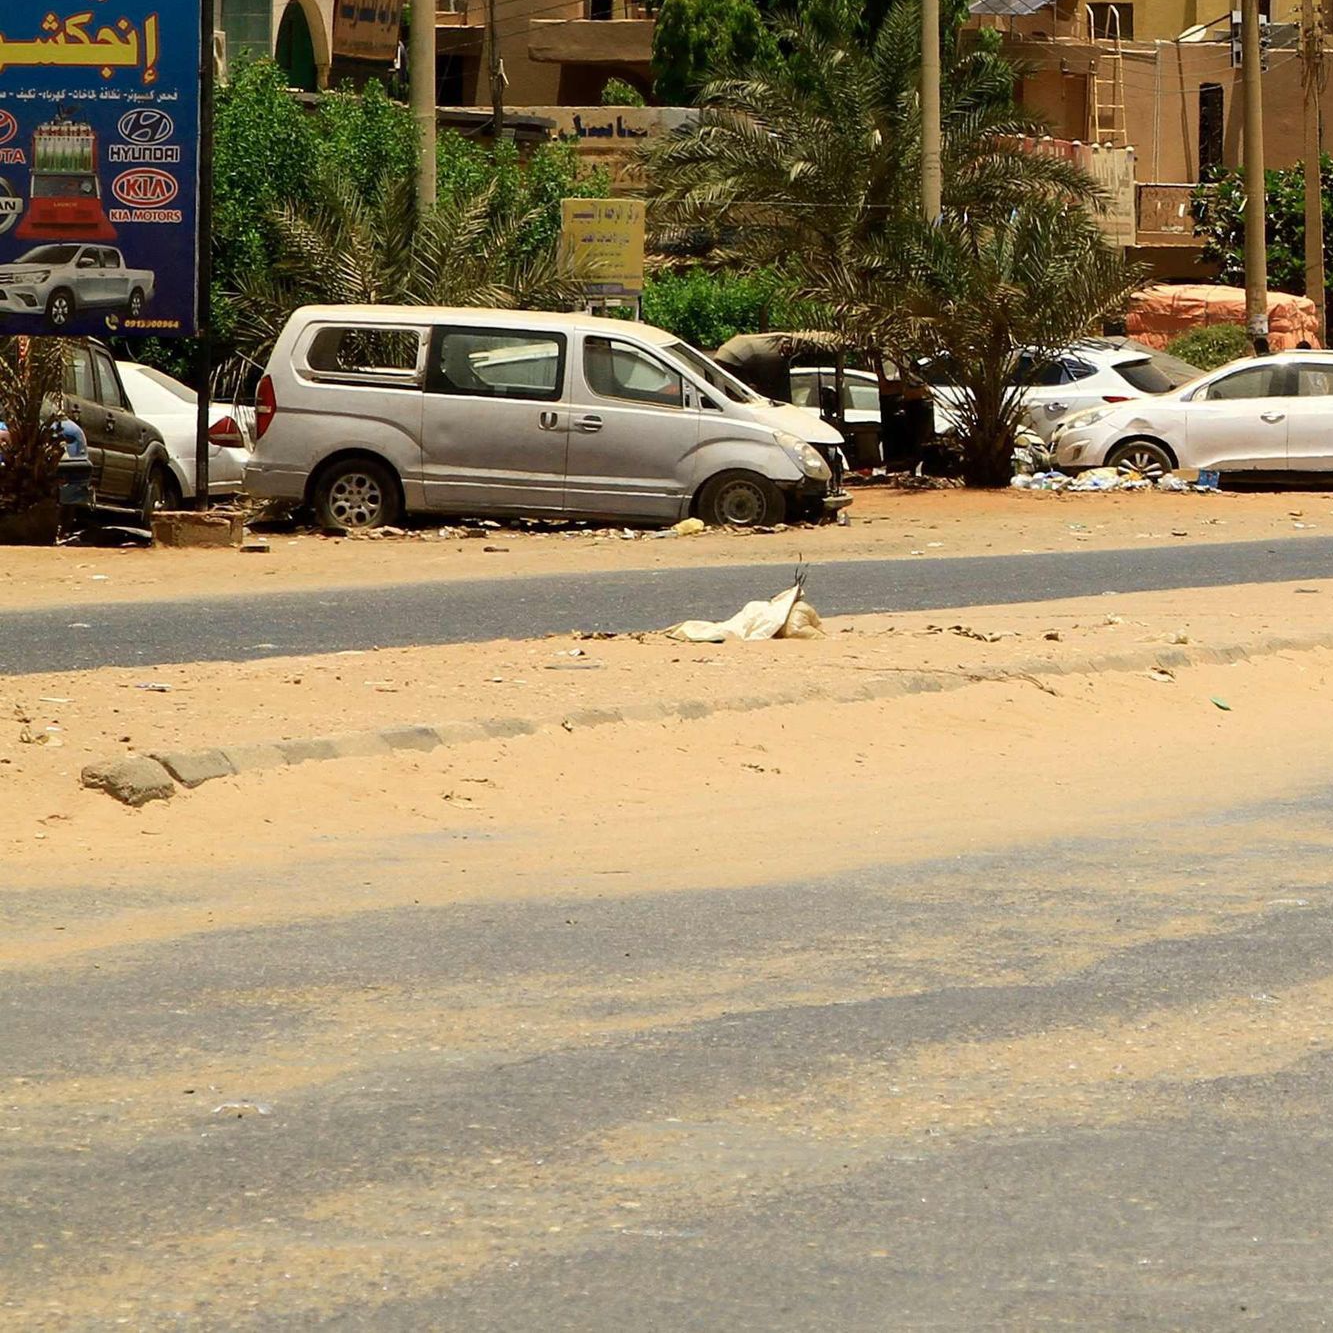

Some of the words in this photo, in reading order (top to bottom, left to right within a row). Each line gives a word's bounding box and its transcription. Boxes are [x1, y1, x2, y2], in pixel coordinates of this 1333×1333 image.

[109, 145, 181, 163] HYUNDAI
[124, 178, 168, 198] KIA
[110, 210, 130, 222] KIA
[132, 210, 182, 223] MOTORS
